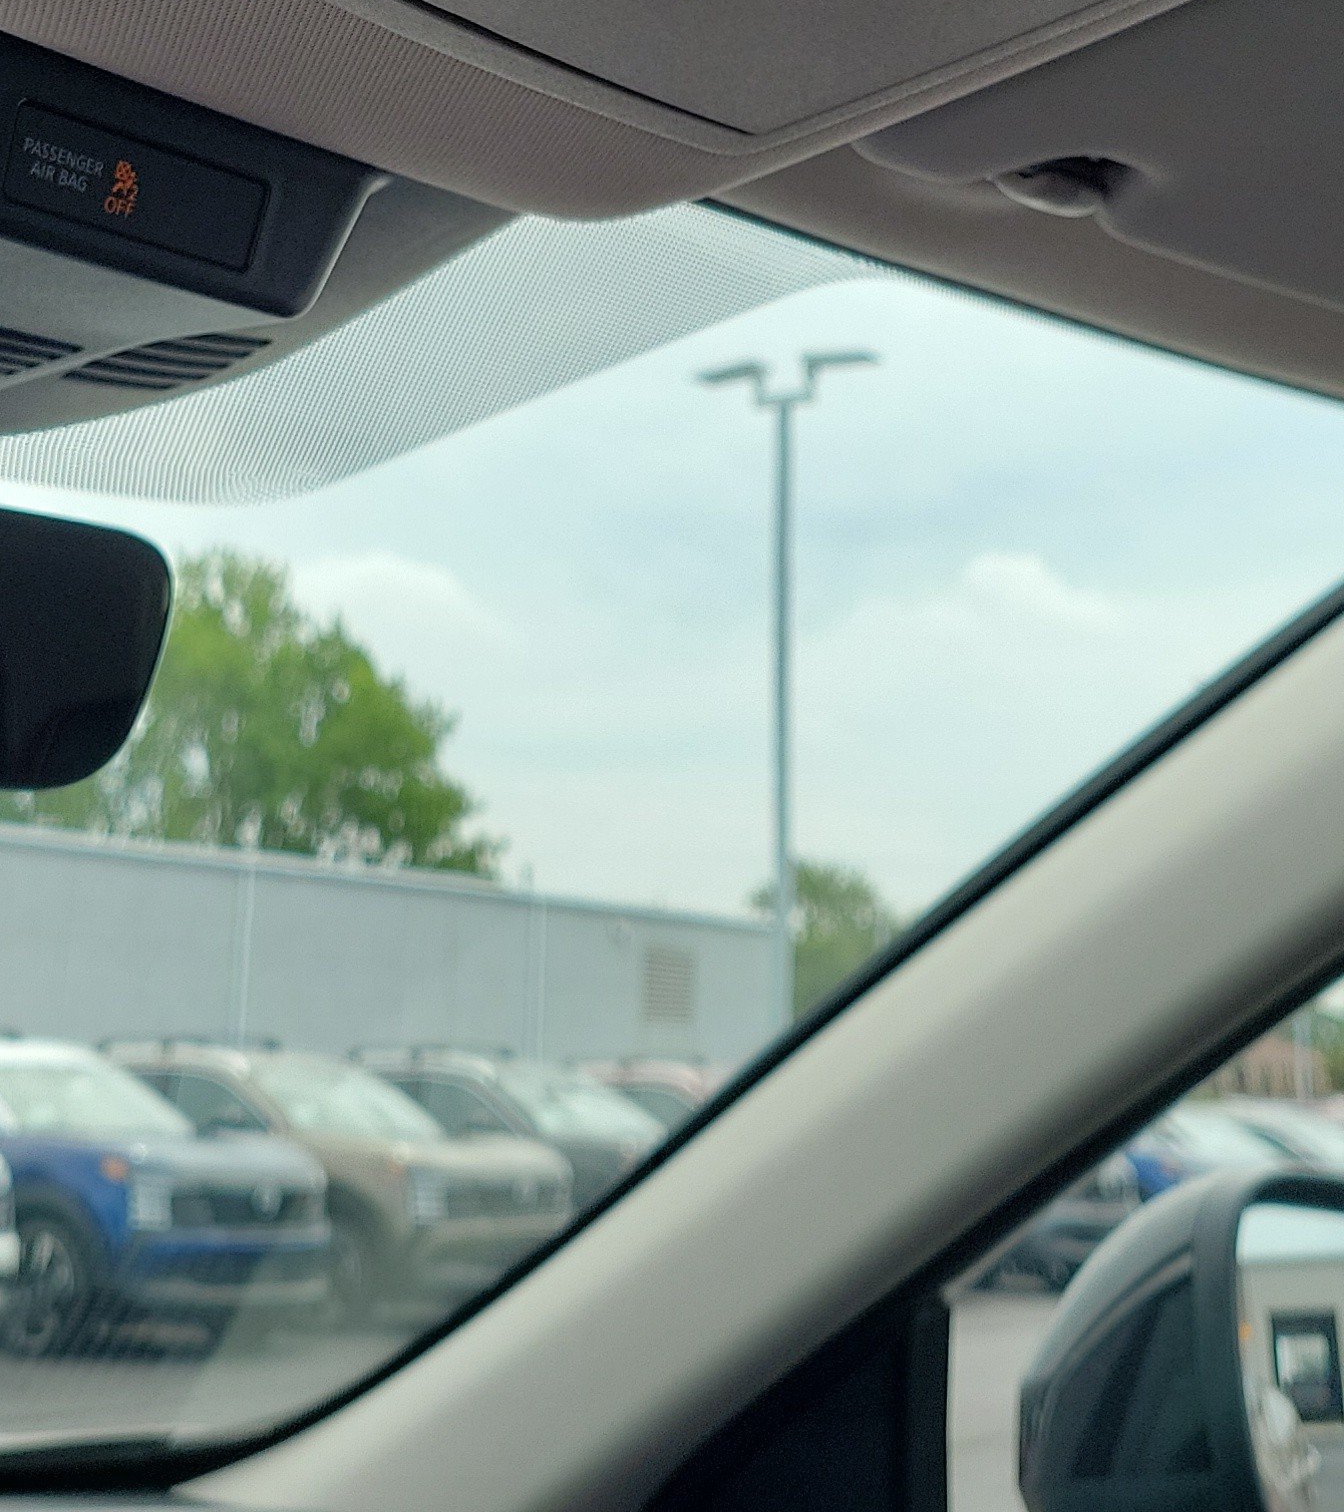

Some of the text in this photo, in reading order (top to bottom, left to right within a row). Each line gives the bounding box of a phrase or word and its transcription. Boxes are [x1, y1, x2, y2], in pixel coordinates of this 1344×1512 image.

[24, 138, 103, 176] PASSENGER
[30, 160, 89, 193] AIR BAG
[104, 196, 137, 218] OFF
